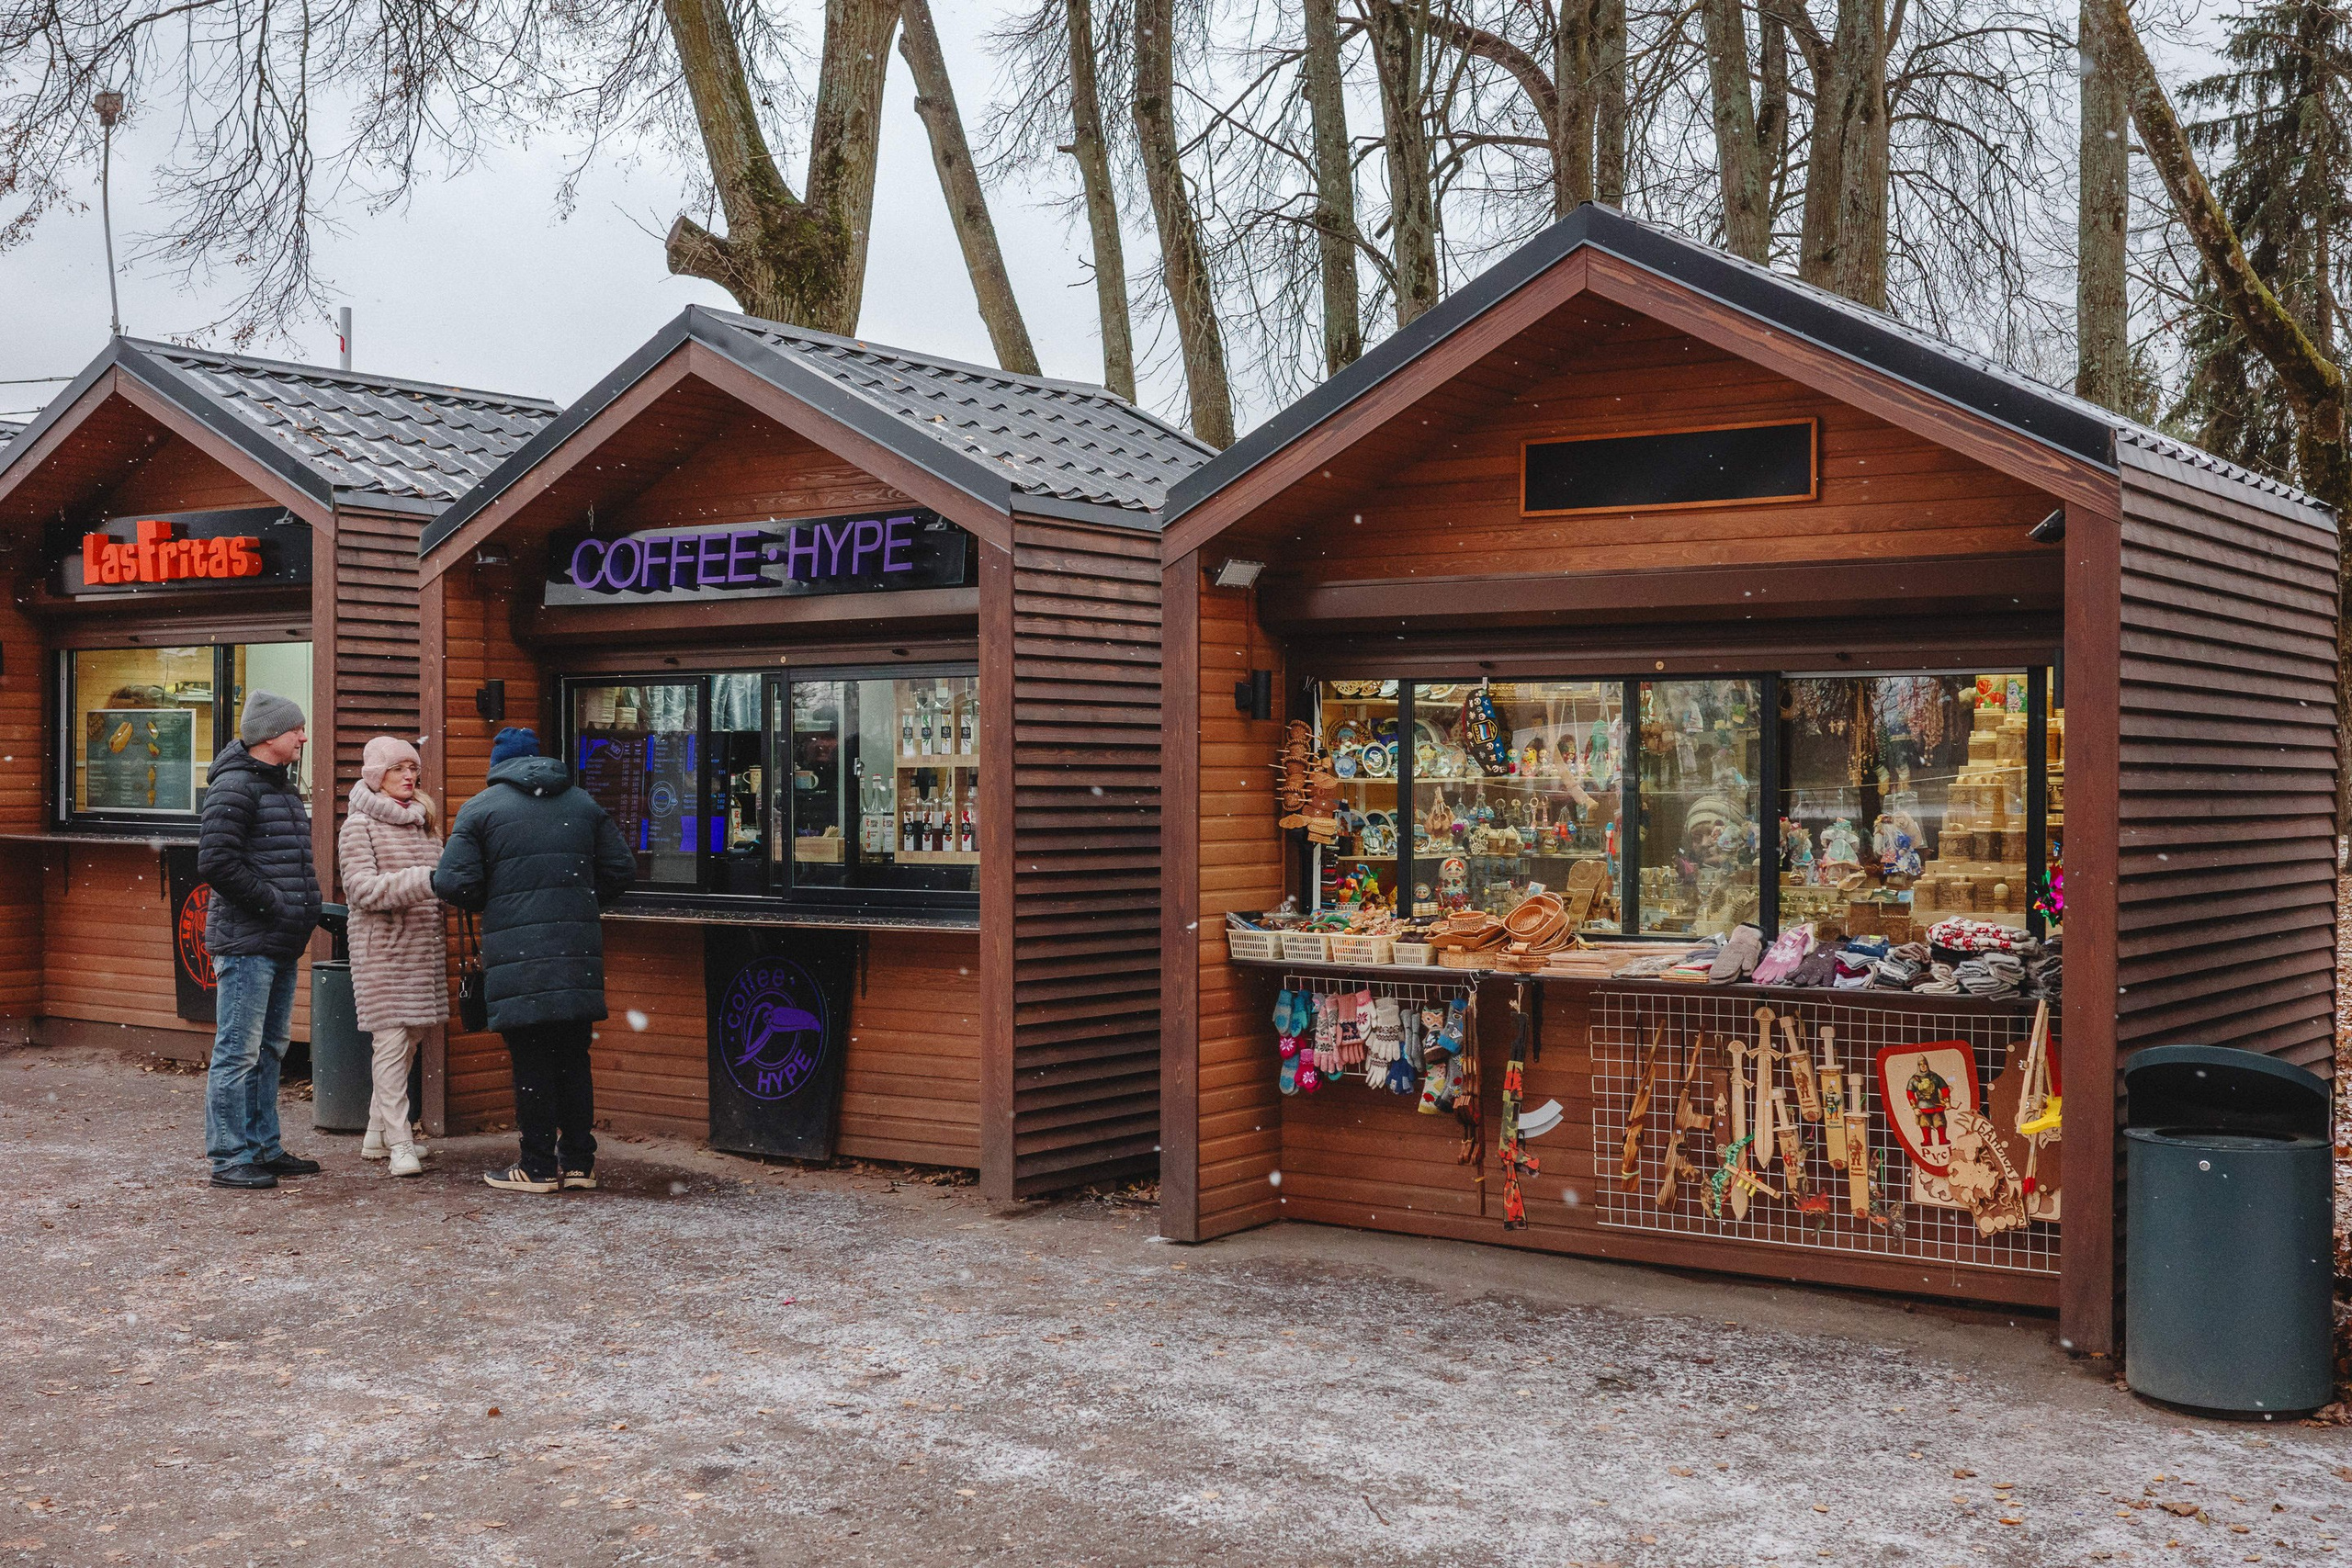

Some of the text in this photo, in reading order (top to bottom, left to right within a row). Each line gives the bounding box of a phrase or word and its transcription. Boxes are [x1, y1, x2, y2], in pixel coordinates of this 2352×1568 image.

[571, 515, 915, 590] COFFEE HYPE
[756, 1048, 812, 1094] HYPE
